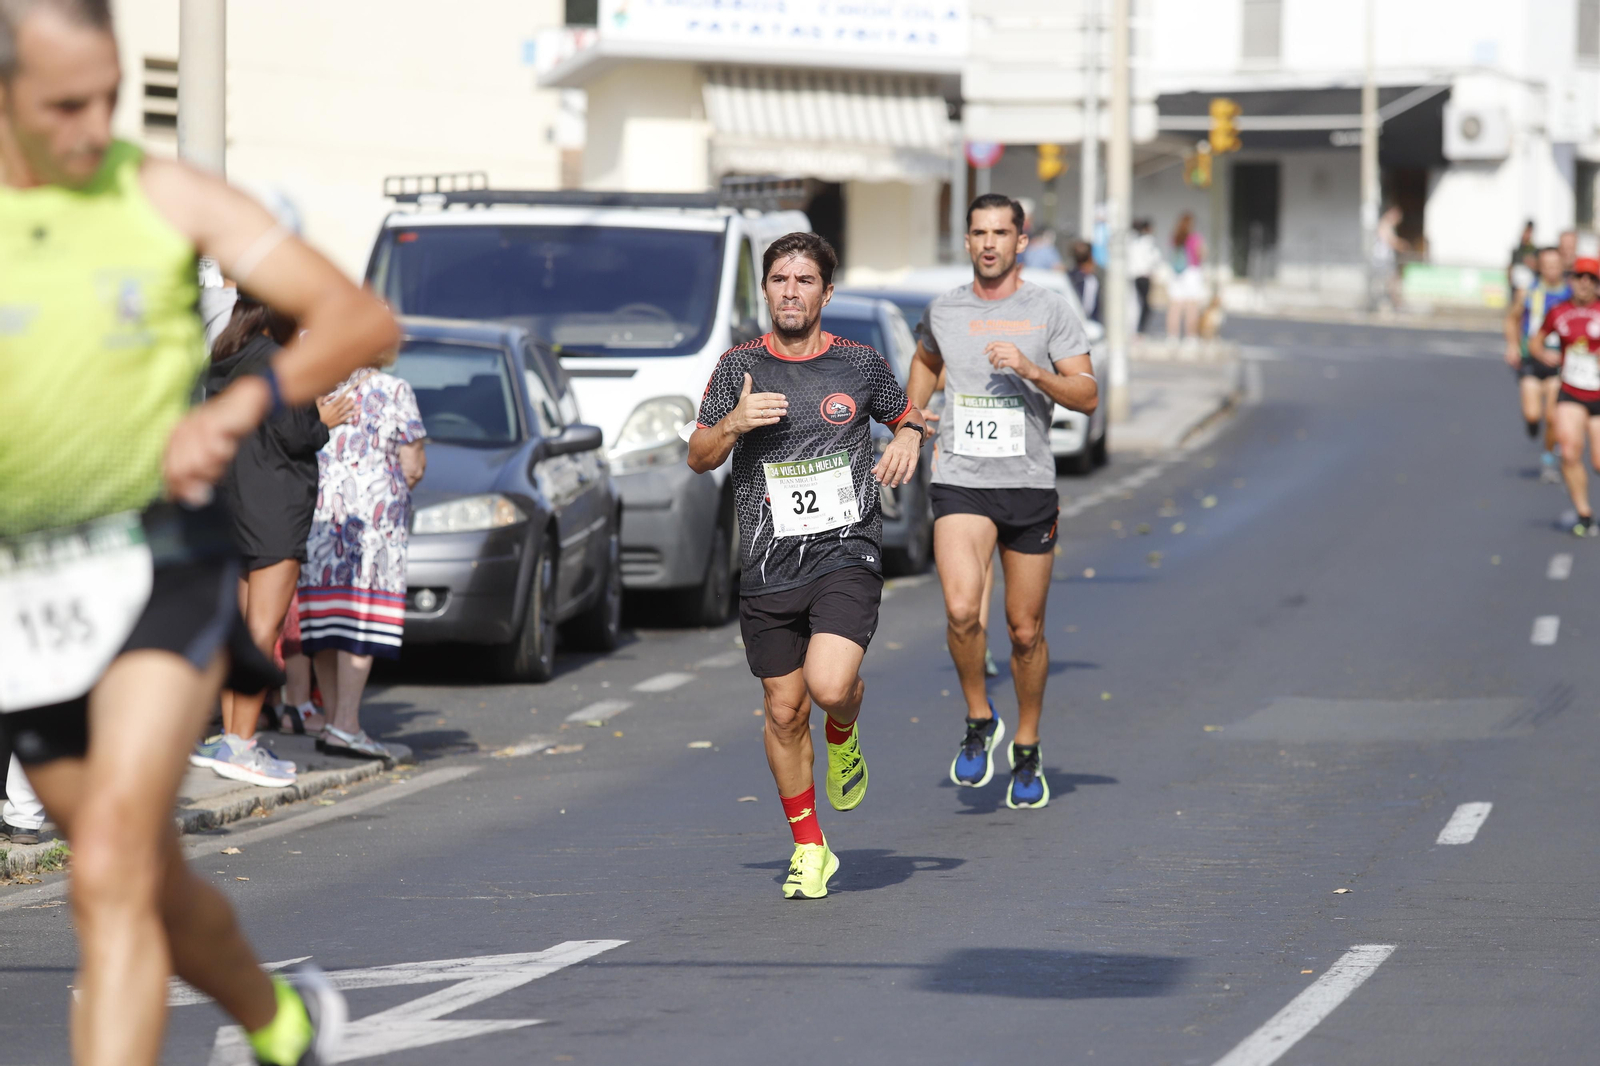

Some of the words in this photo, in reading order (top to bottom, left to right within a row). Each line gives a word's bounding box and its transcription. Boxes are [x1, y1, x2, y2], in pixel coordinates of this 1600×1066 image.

[965, 419, 998, 440] 412
[770, 467, 780, 477] 34
[780, 465, 807, 476] VUELTA
[809, 463, 815, 474] A
[816, 457, 843, 473] HUELVA
[791, 489, 820, 515] 32
